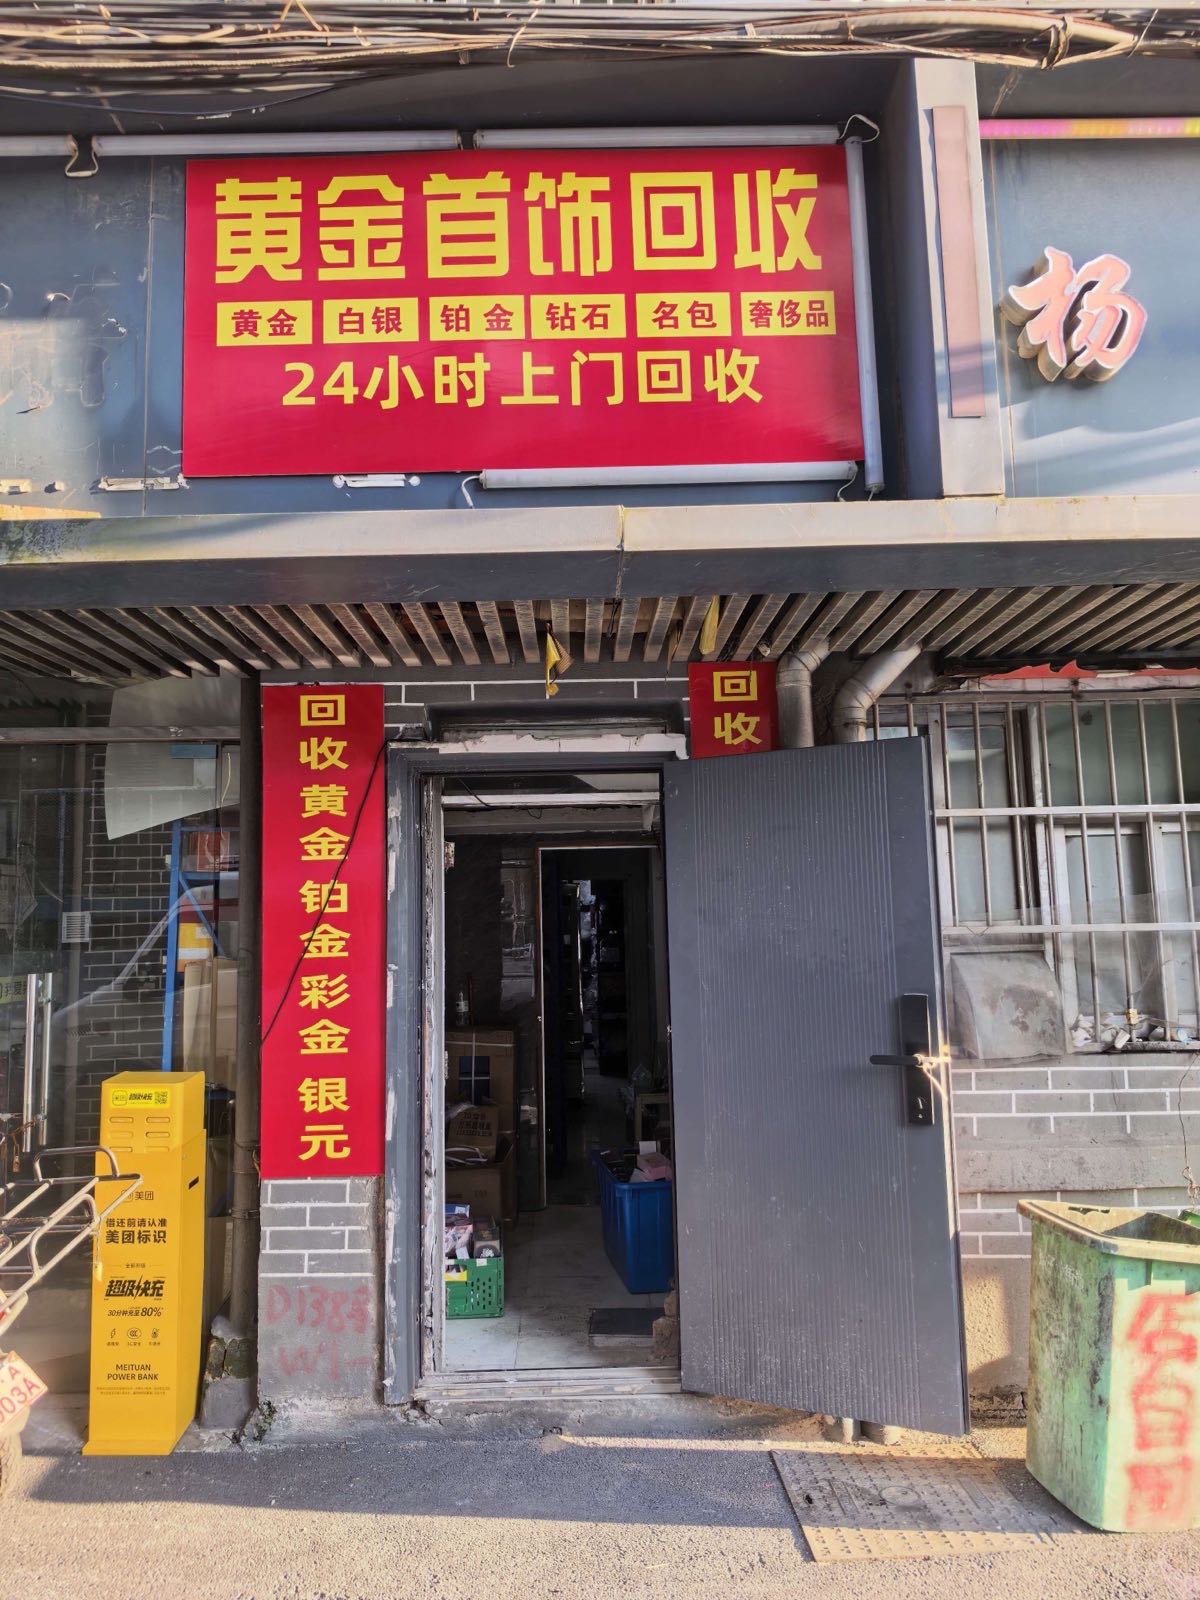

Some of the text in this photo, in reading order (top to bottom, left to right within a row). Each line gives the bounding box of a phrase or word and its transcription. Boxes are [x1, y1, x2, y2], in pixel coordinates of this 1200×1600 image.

[214, 168, 823, 284] 黄金首饰回收
[230, 299, 831, 339] 黄金 白银 铂金 钻石 名包 奢侈品
[282, 348, 763, 410] 24小时上门回收
[713, 670, 763, 746] 回收
[135, 1191, 154, 1200] 美团
[106, 1218, 167, 1228] 借还前请认准
[106, 1230, 167, 1244] 美团标识
[107, 1373, 159, 1381] POWER BANK
